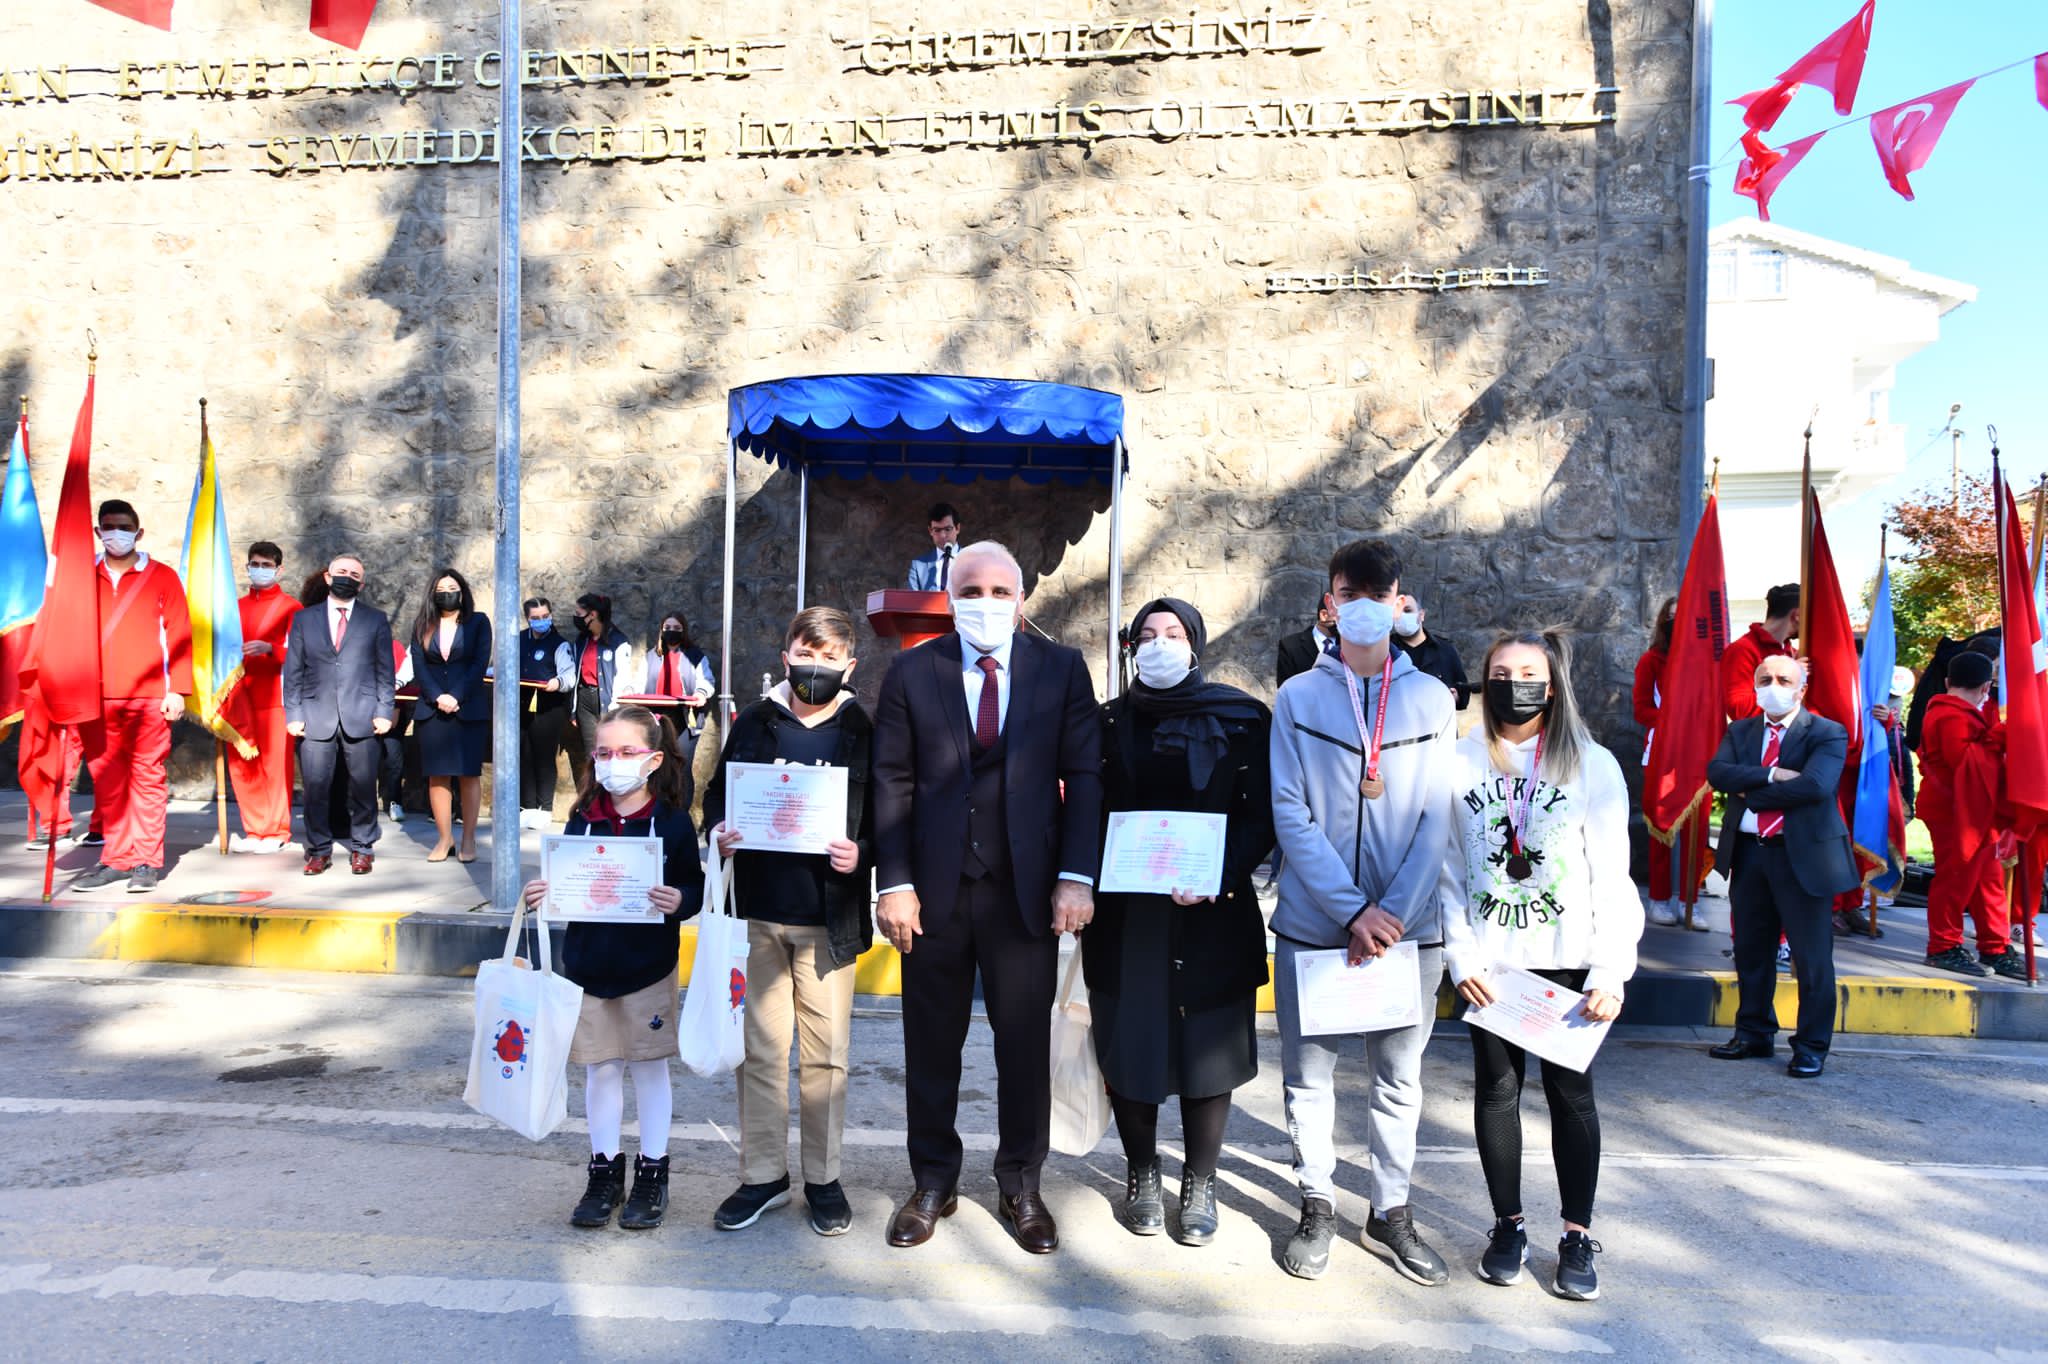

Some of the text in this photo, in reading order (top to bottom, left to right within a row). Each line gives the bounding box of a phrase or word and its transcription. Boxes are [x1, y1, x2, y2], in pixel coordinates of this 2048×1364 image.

[474, 41, 750, 88] CENNETE
[641, 121, 706, 160] DE
[924, 95, 1106, 149] ETMİŞ
[1479, 892, 1565, 929] MOUSE
